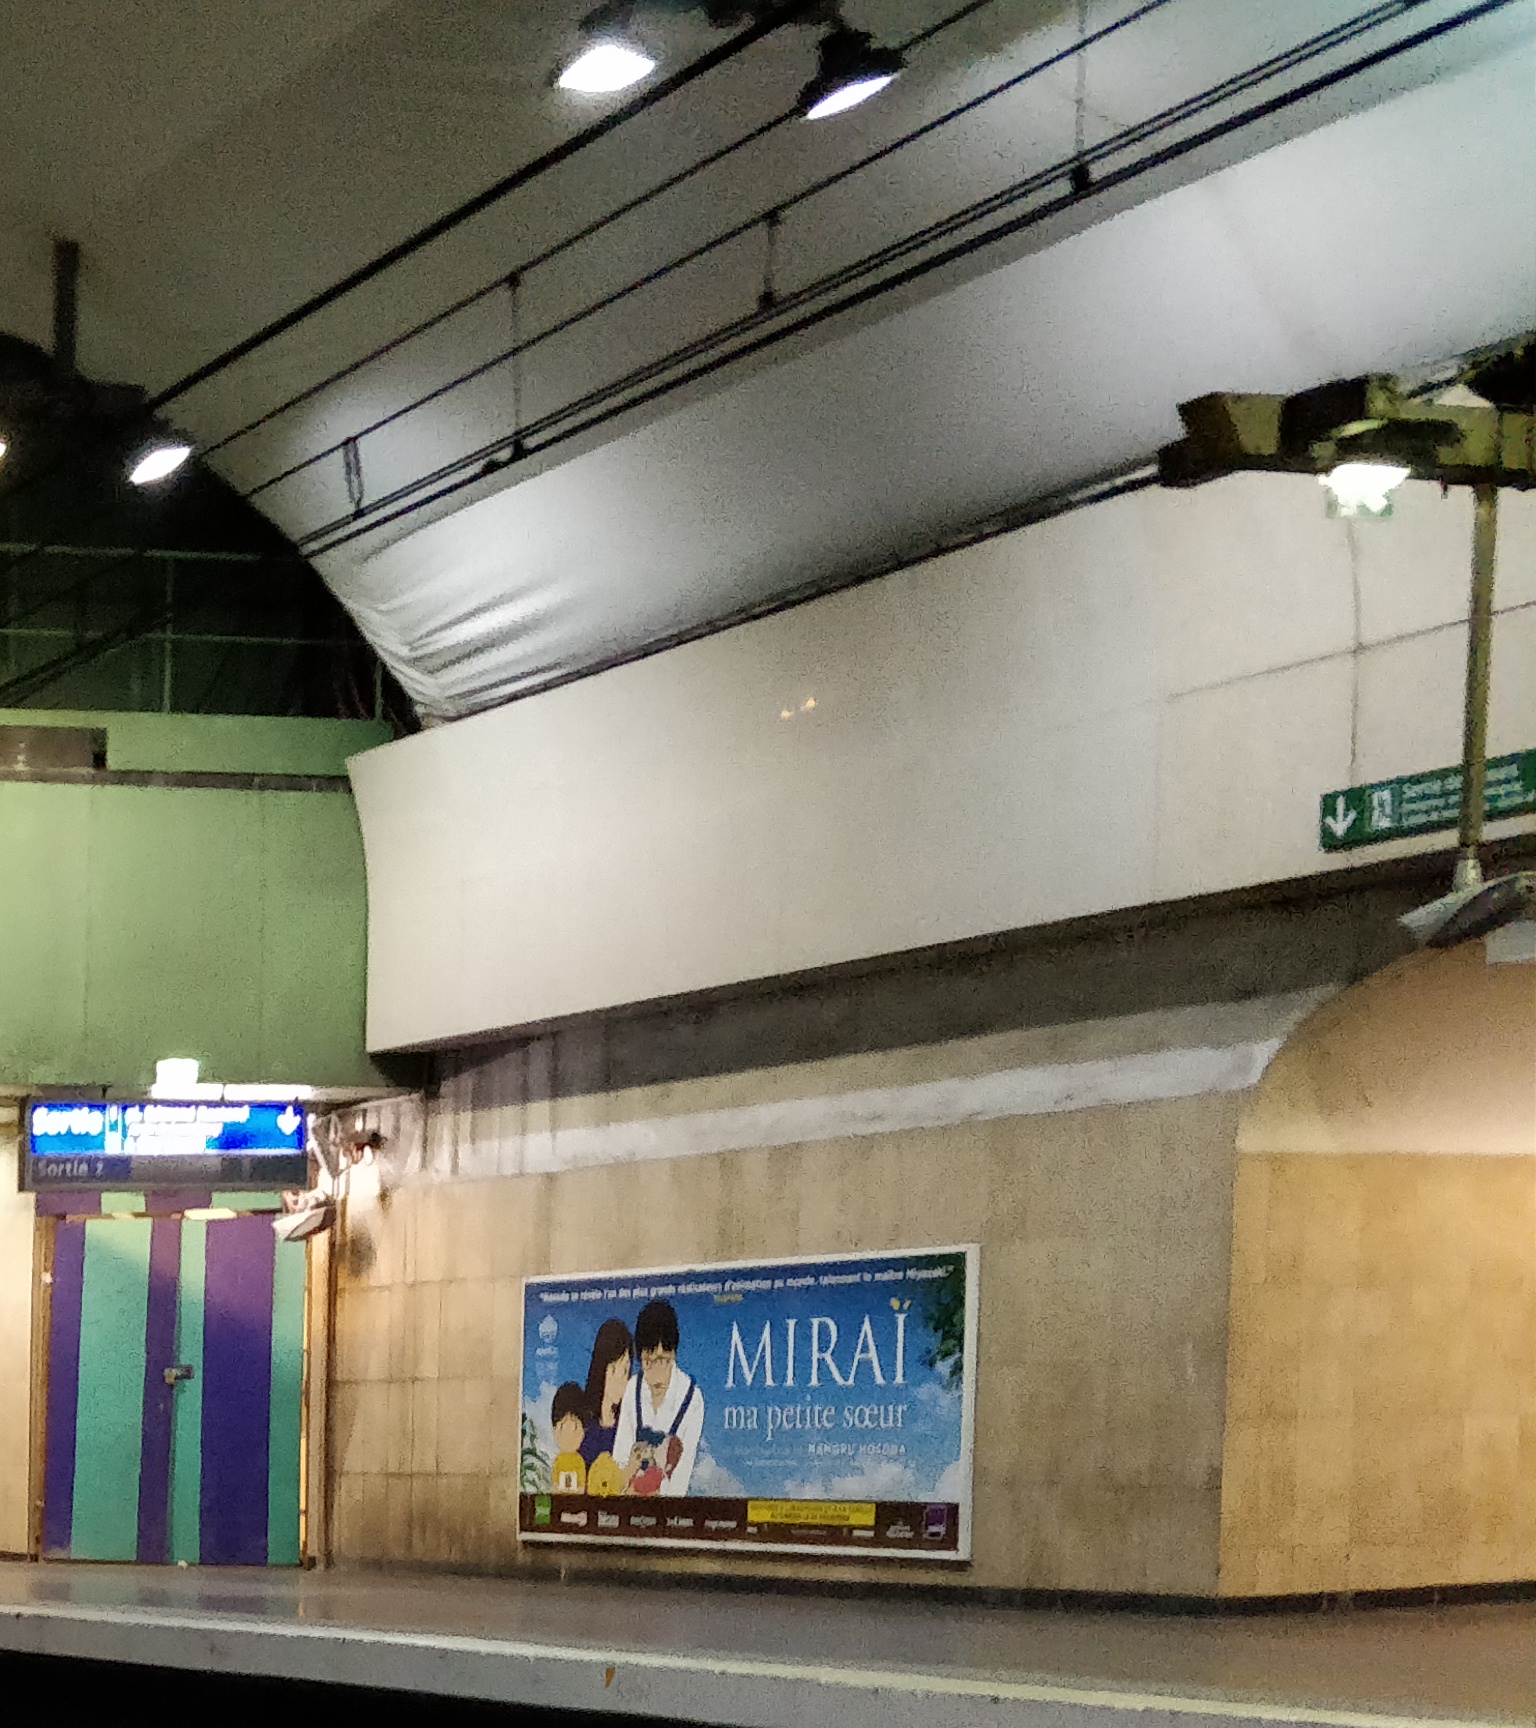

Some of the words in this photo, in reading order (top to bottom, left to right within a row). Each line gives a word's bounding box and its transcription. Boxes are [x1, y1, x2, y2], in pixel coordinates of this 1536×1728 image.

[725, 1296, 912, 1389] MIRAÏ
[724, 1404, 760, 1430] ma
[765, 1393, 836, 1441] petite
[842, 1403, 909, 1430] sœur
